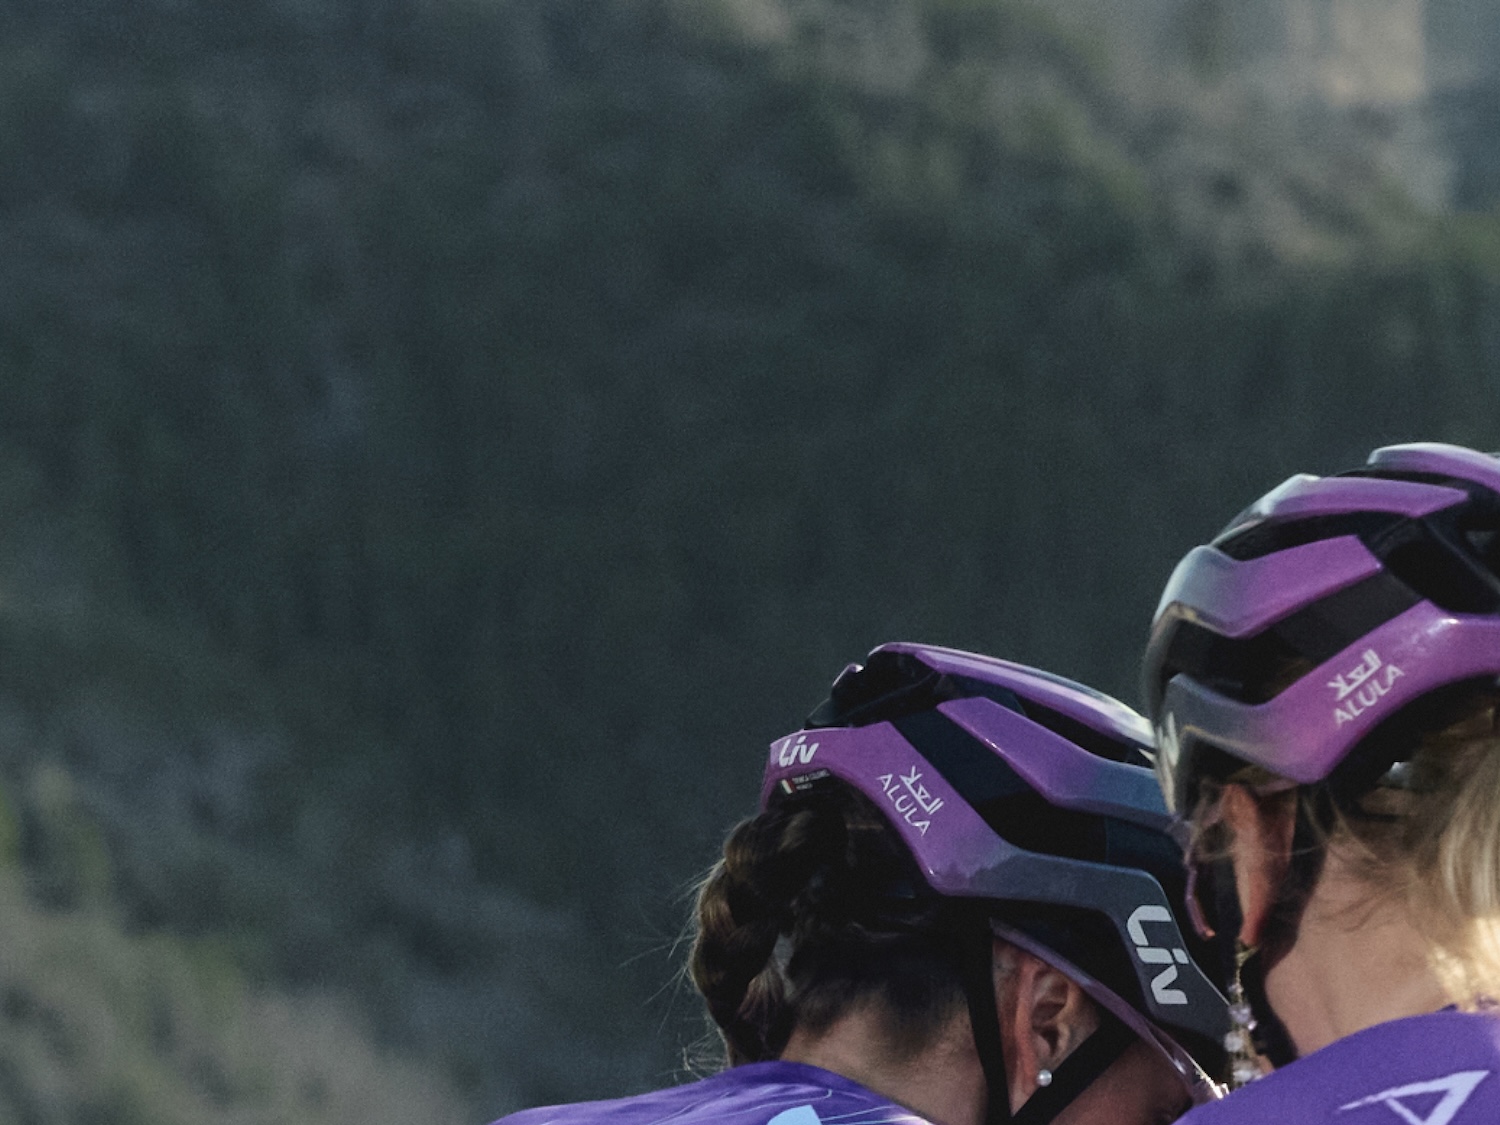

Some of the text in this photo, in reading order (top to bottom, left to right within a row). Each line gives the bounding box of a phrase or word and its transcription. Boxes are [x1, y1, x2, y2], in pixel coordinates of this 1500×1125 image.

[1334, 664, 1405, 727] ALULA
[778, 735, 820, 768] Liv
[876, 773, 931, 837] ALULA
[1127, 904, 1190, 1005] Liv
